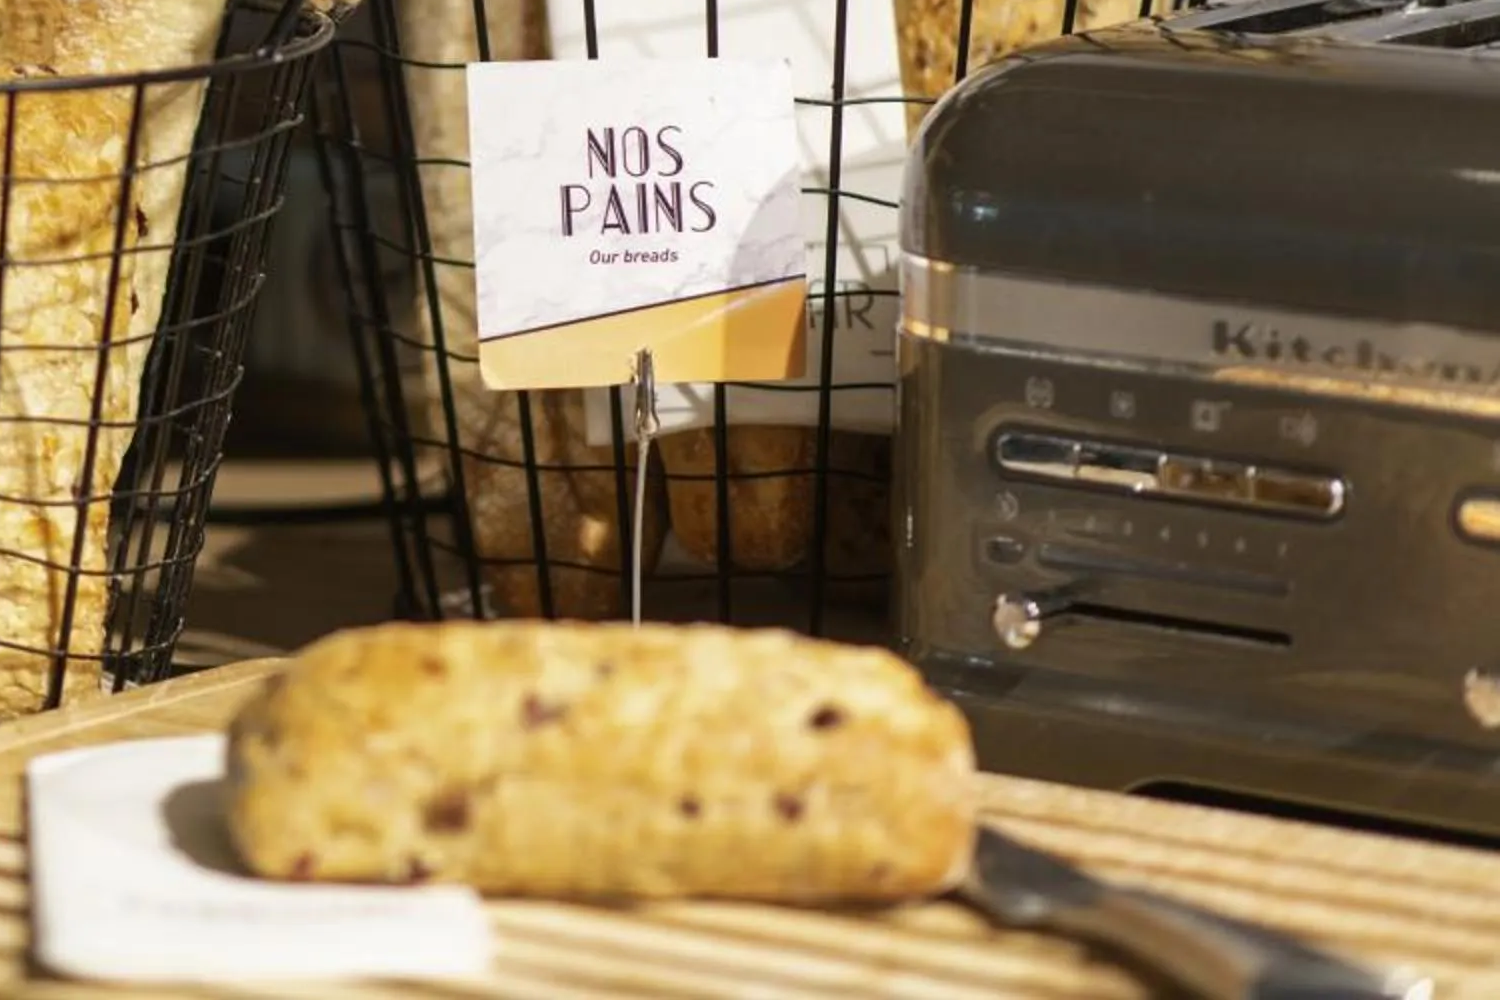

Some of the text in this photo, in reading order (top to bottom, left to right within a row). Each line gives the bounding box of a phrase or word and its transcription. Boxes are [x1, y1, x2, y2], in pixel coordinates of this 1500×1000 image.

[586, 124, 684, 179] NOS
[560, 181, 717, 237] PAINS
[589, 248, 679, 264] Our breads
